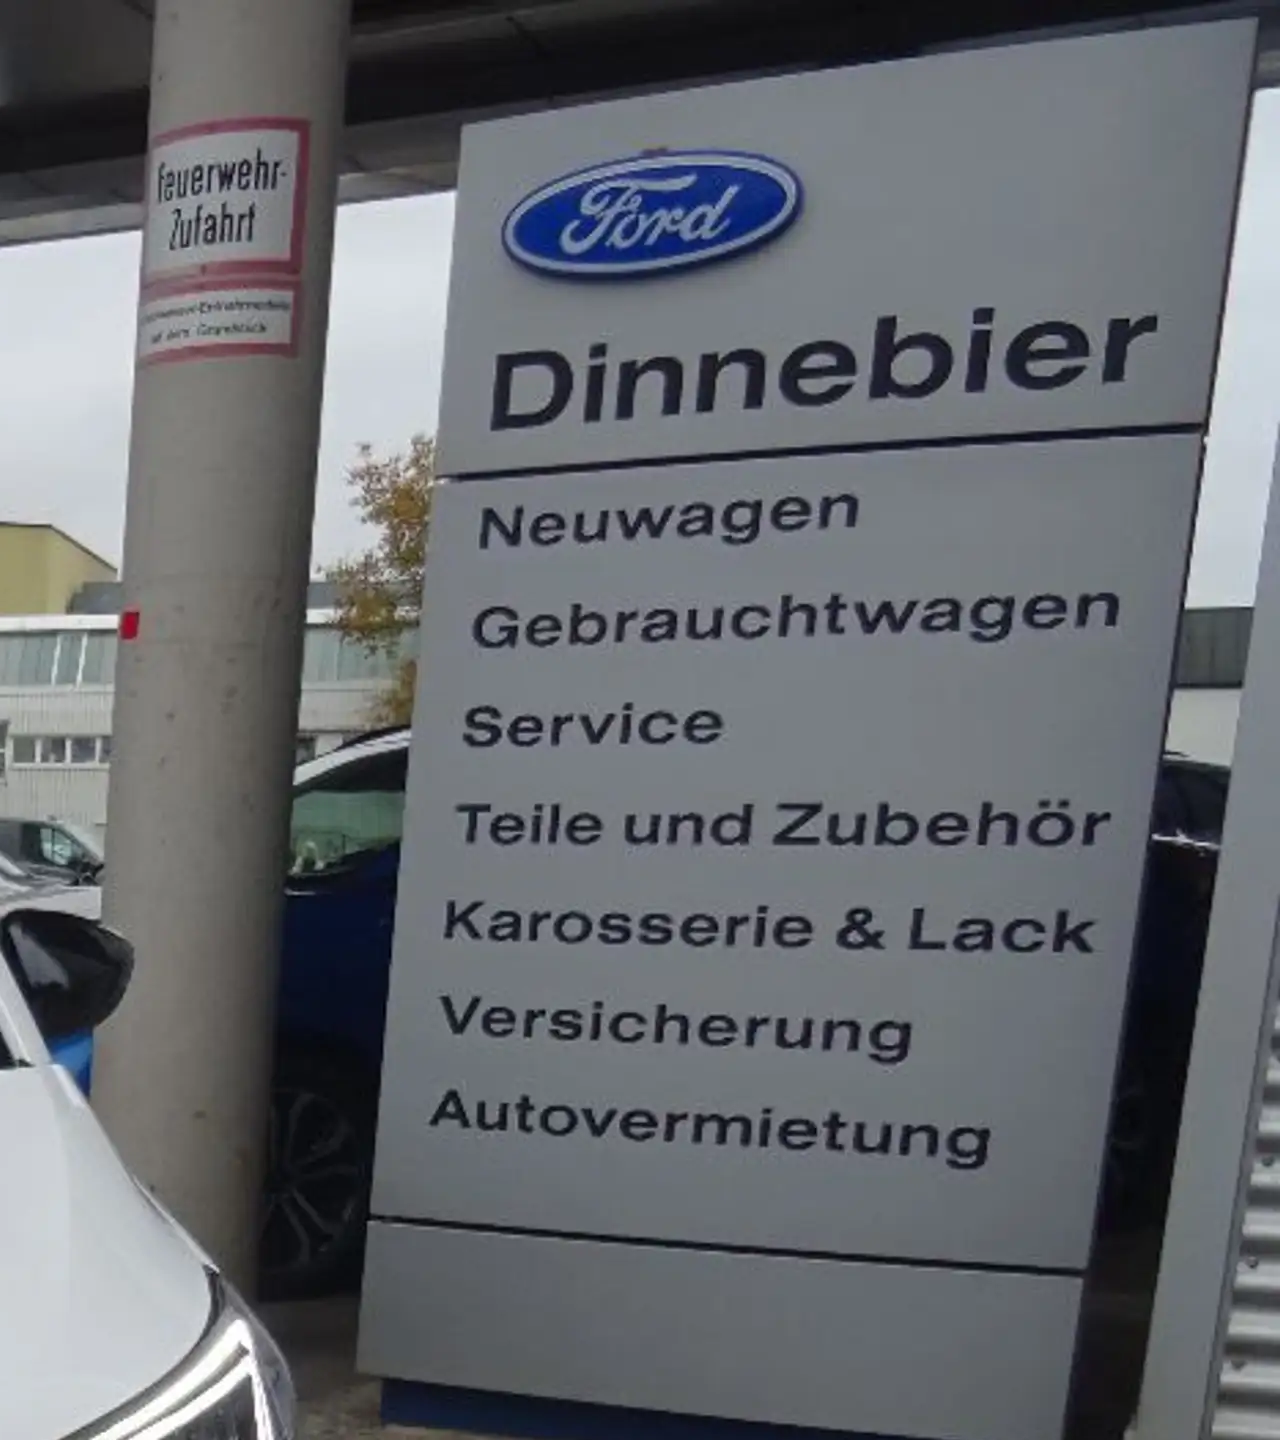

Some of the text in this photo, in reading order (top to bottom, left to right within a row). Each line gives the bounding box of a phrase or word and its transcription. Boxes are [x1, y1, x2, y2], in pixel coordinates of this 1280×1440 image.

[169, 201, 256, 251] Zufahrt
[560, 172, 740, 256] Ford
[490, 308, 1158, 431] Dinnebier
[479, 493, 860, 550] Neuwagen
[472, 592, 1120, 649] Gebrauchtwagen
[462, 702, 725, 748] Service
[456, 799, 1113, 848] Teile und Zubehör
[443, 899, 1096, 954] Karosserie & Lack
[439, 995, 913, 1065] Versicherung
[428, 1089, 991, 1171] Autovermietung
